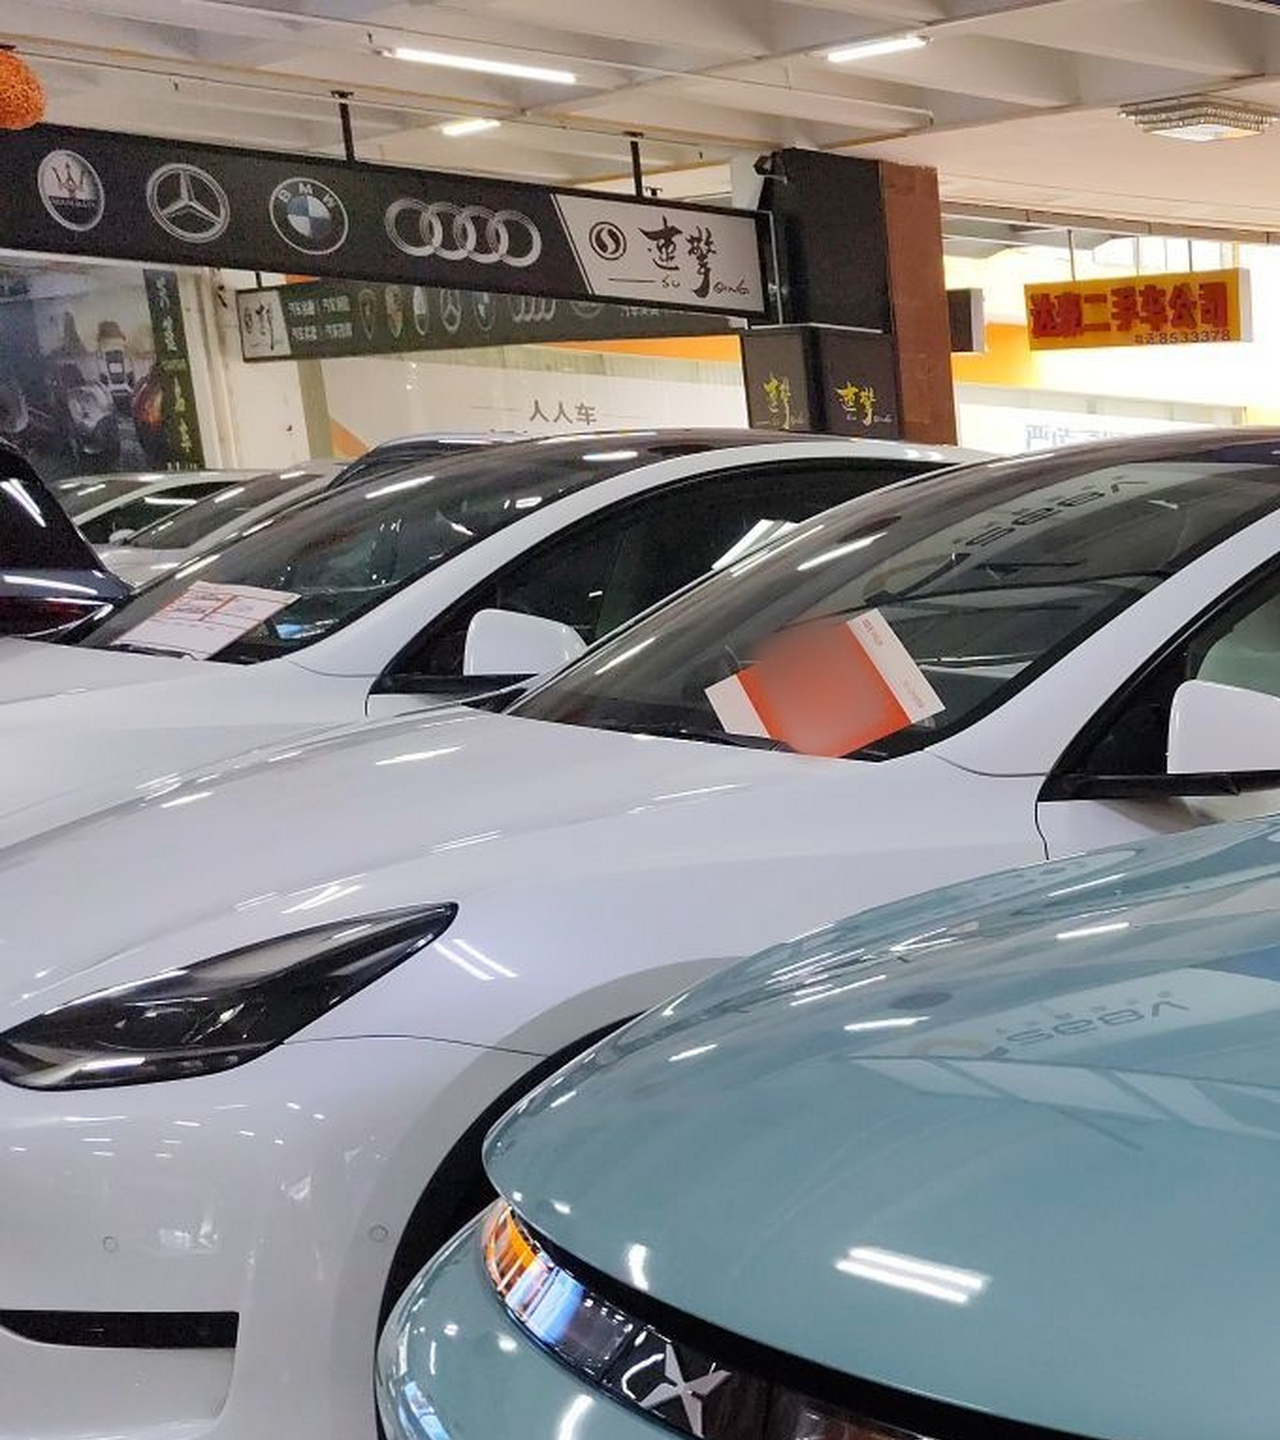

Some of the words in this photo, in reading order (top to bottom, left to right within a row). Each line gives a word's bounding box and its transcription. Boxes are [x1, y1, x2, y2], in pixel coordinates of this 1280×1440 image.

[278, 182, 337, 210] BMW
[529, 399, 598, 426] 人人车
